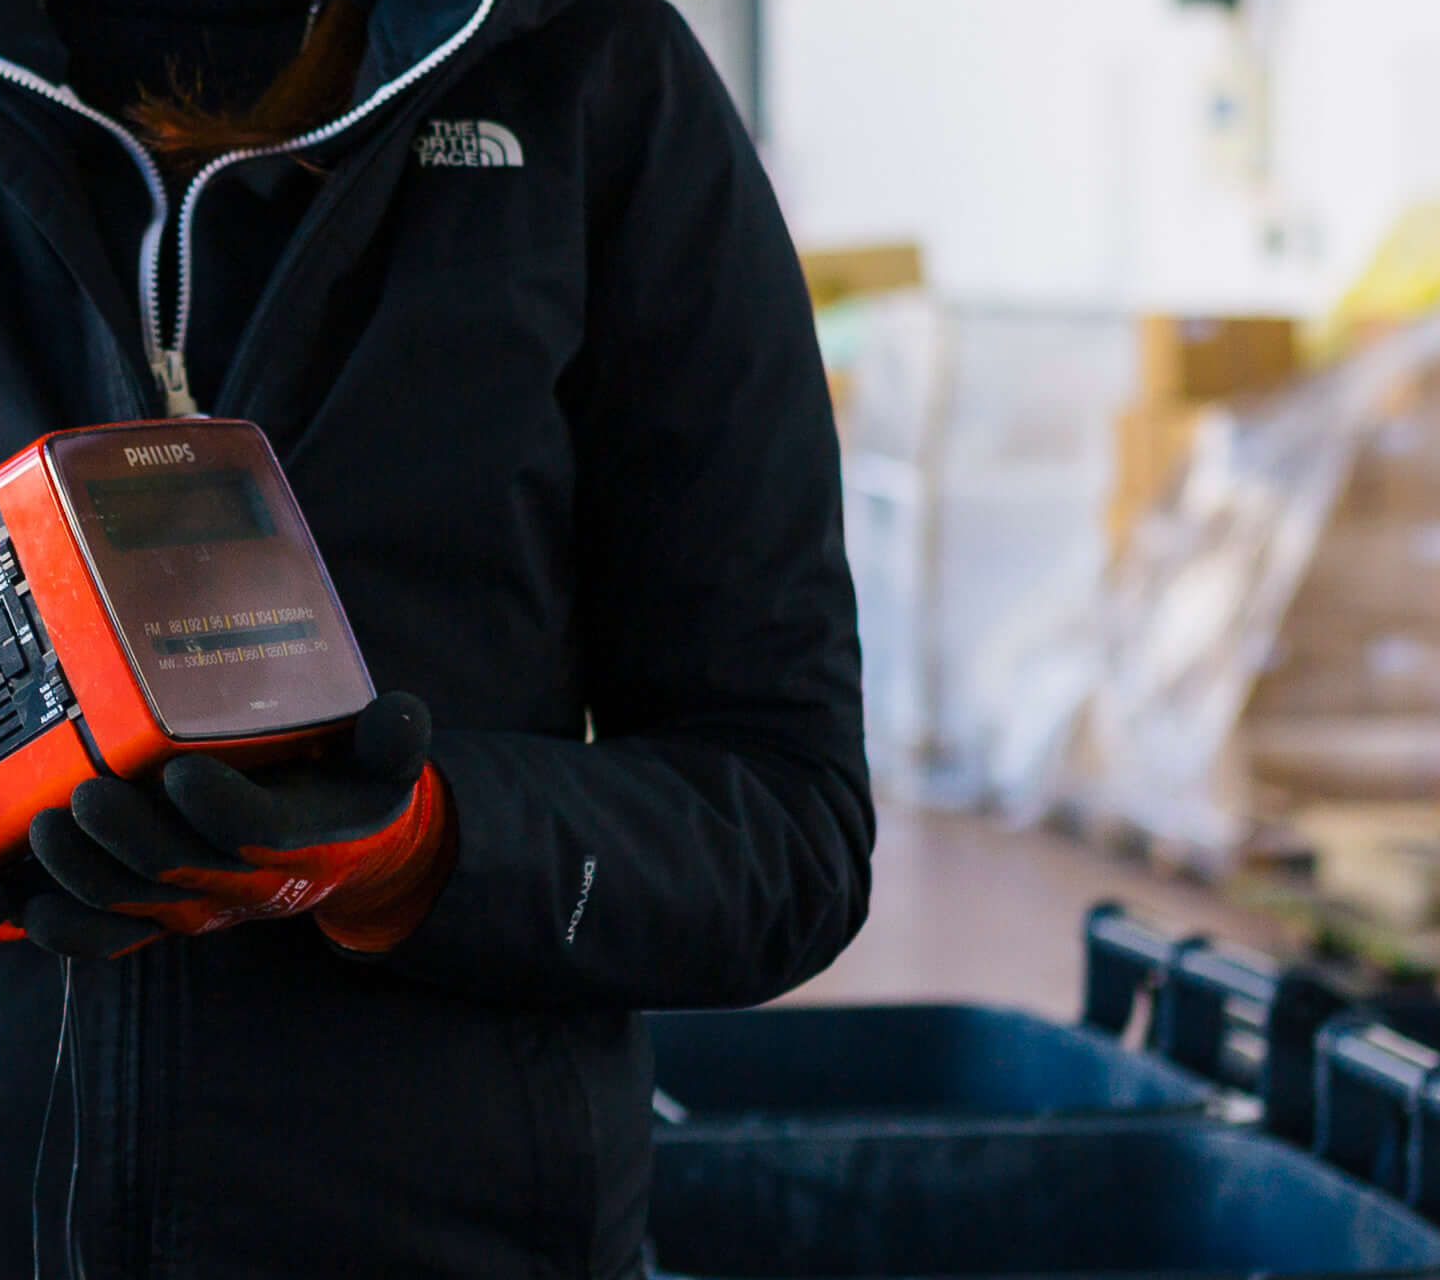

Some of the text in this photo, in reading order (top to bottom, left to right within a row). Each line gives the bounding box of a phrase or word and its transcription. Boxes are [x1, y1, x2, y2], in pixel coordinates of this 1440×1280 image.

[430, 120, 474, 136] THE
[411, 136, 479, 152] ORTH
[421, 151, 480, 166] FACE
[123, 442, 196, 468] PHILIPS
[143, 621, 161, 637] FM
[231, 612, 250, 627] 100
